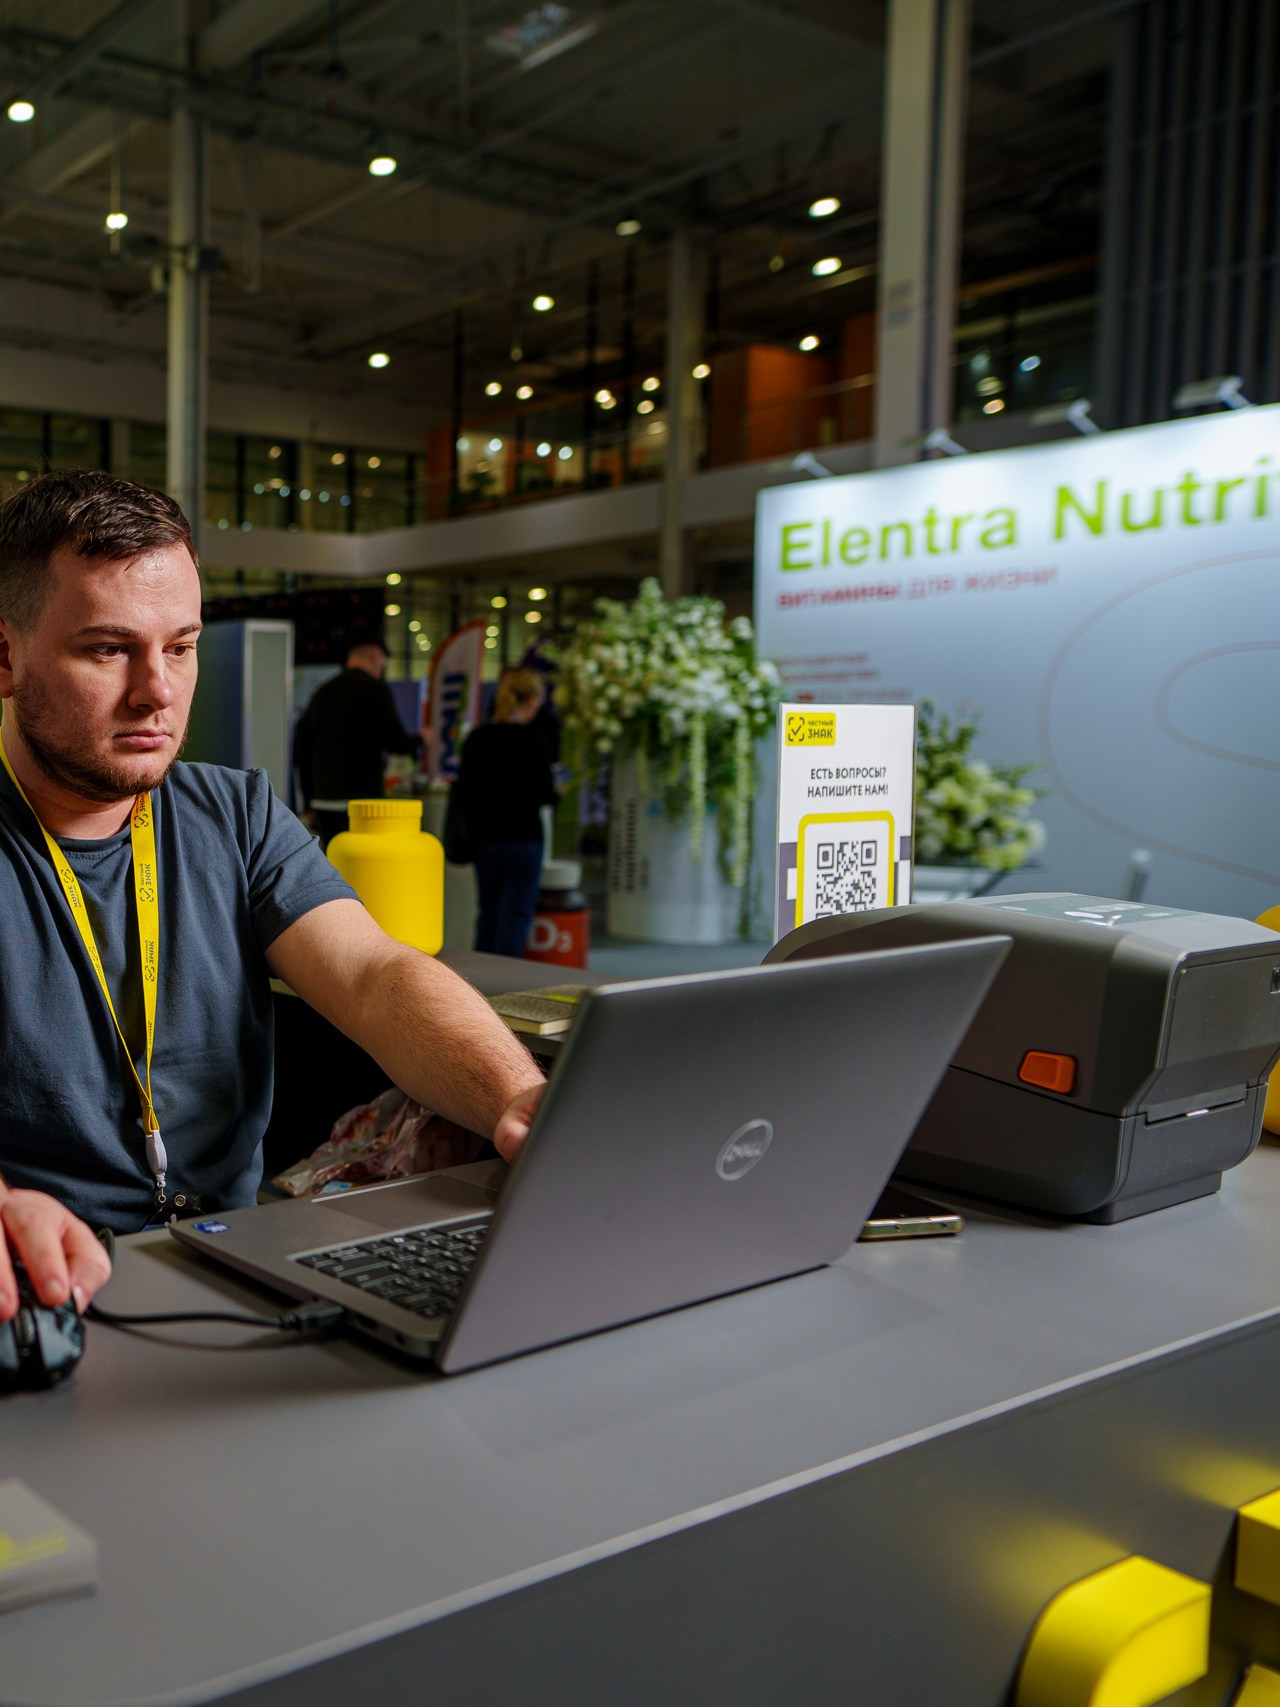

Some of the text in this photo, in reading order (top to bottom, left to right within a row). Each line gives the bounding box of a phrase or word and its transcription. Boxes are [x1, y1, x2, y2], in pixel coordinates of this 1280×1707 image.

[778, 456, 1280, 572] Elentra Nutri
[807, 728, 833, 739] ЗНАК
[810, 766, 887, 780] ЕСТЬ ВОПРОСЫ?
[807, 784, 889, 798] НАПИШИТЕ НАМ!
[144, 863, 152, 886] ЗНАК
[67, 885, 79, 908] ЗНАК
